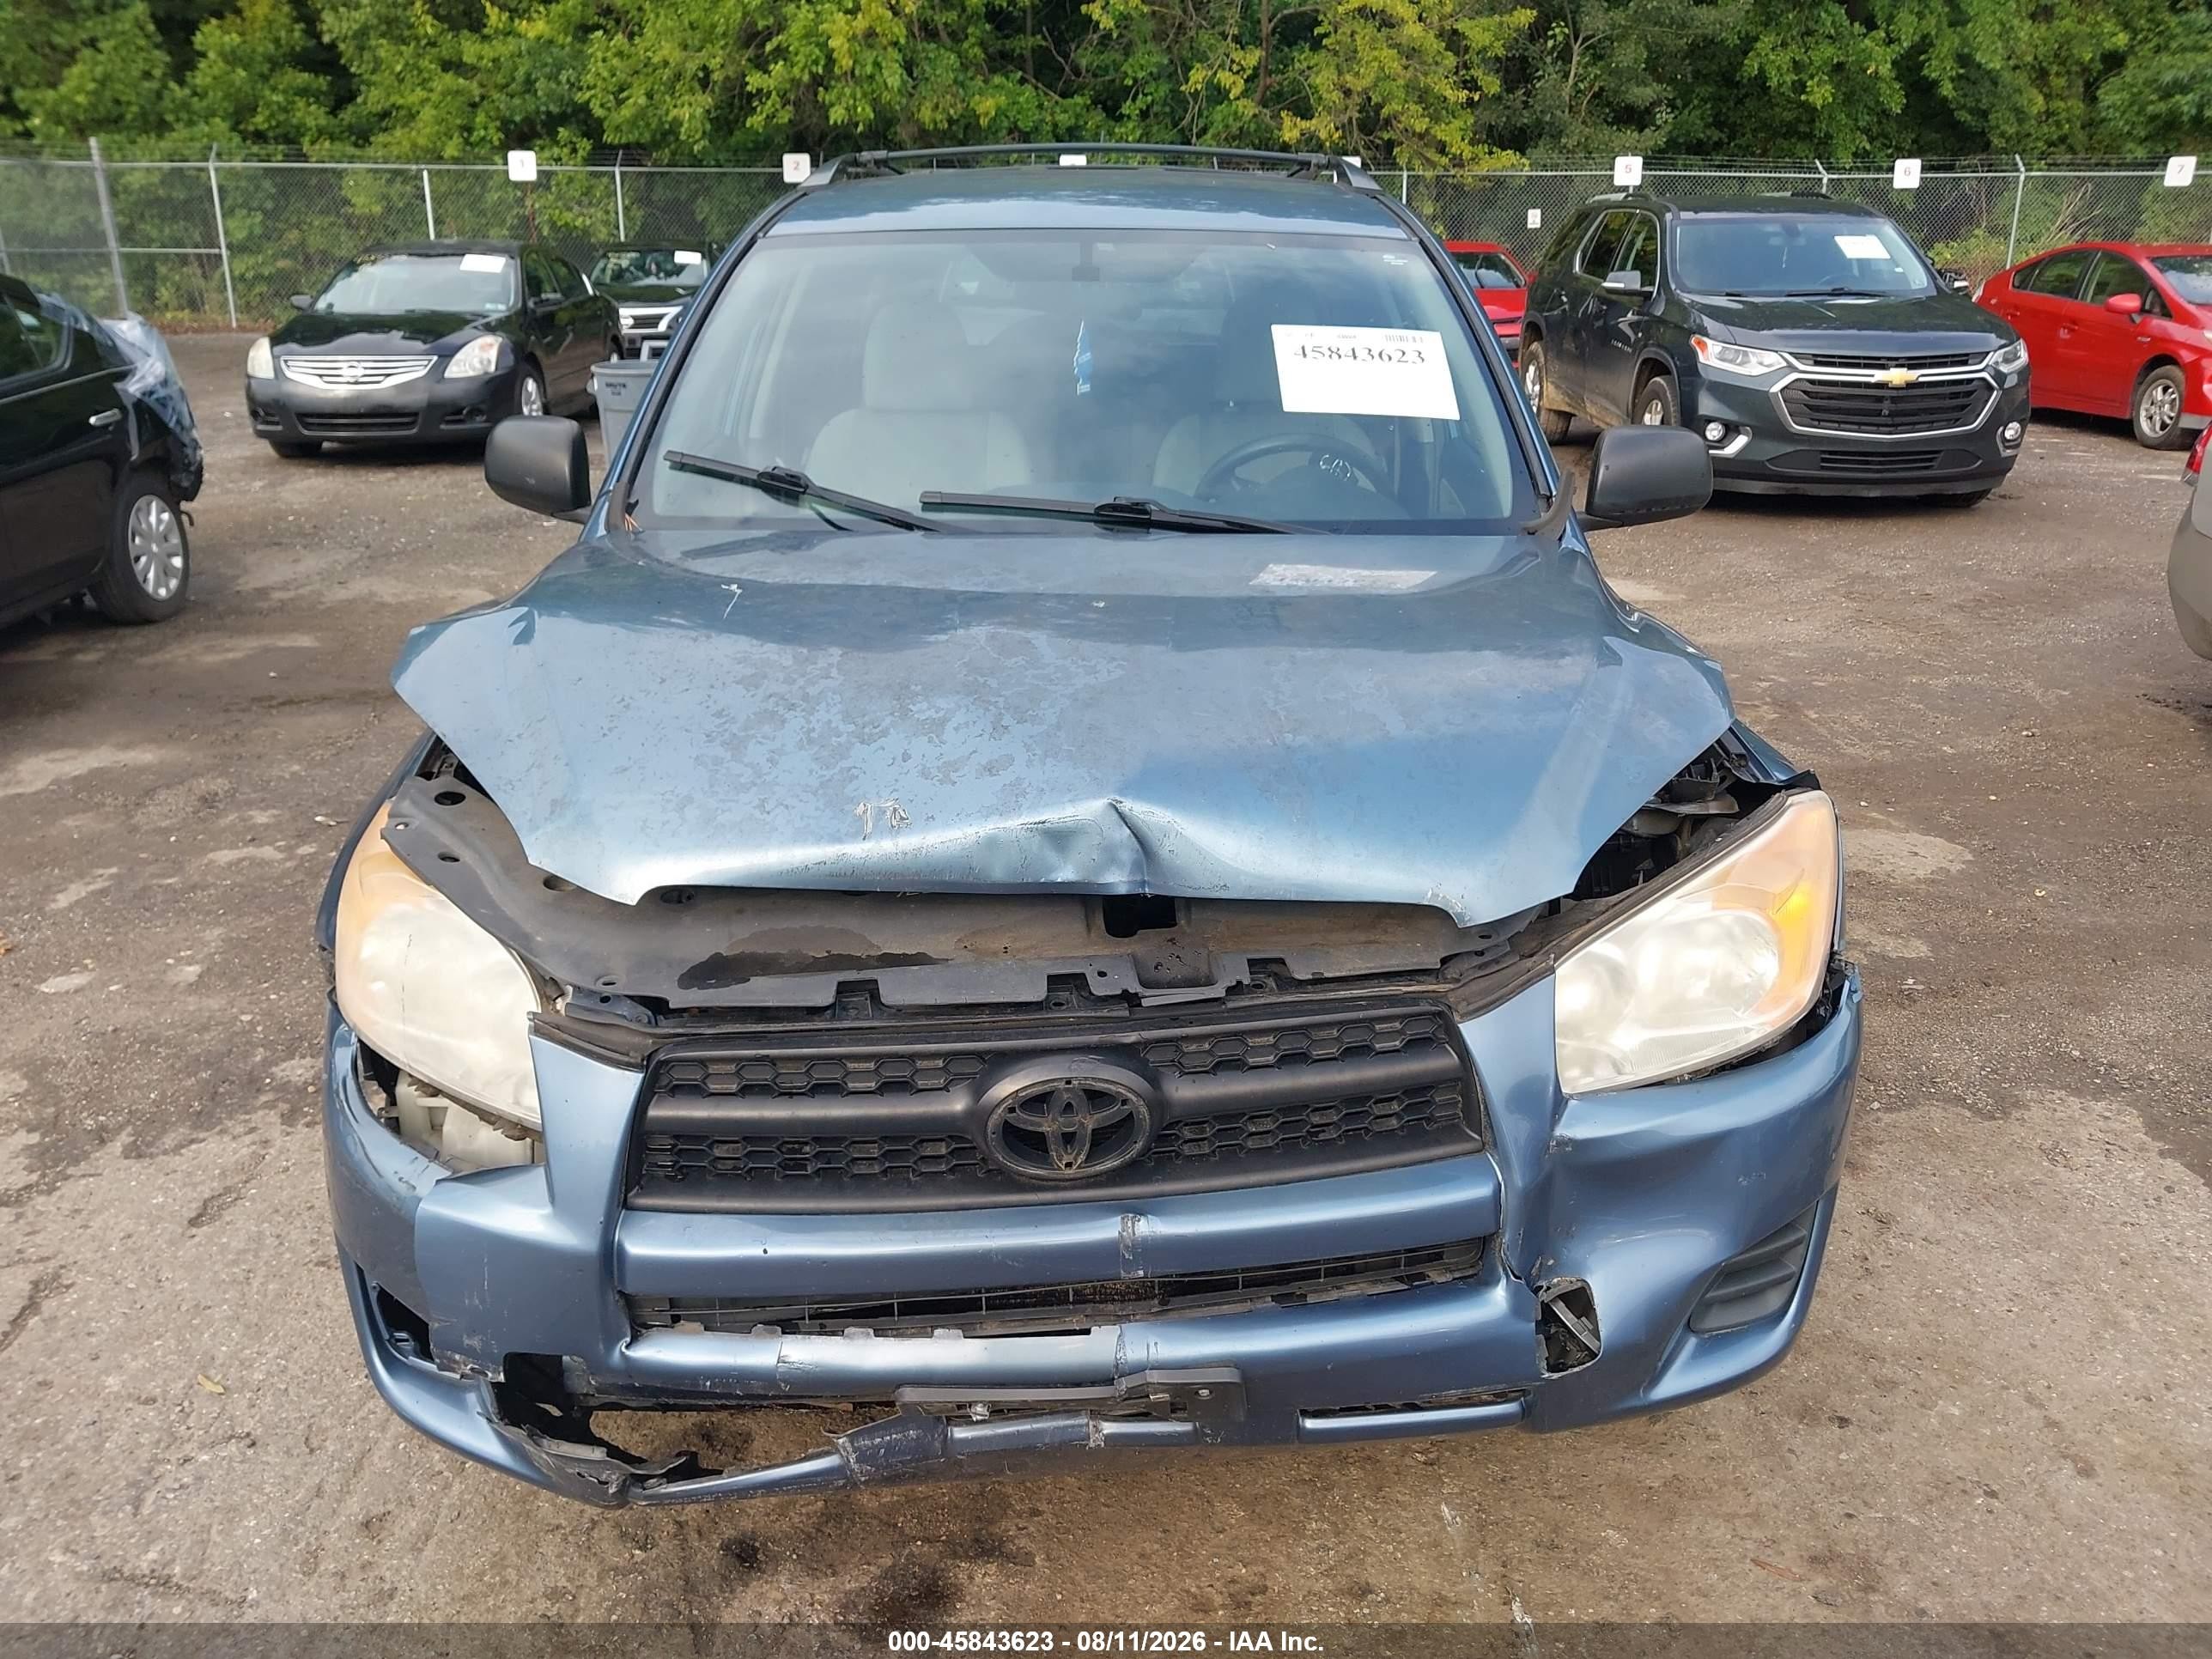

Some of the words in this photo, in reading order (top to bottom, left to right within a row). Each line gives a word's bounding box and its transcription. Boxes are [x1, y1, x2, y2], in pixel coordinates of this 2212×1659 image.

[1625, 164, 1632, 173] 5
[1904, 167, 1911, 176] 6
[2177, 164, 2185, 174] 7
[1293, 344, 1425, 365] 45843623
